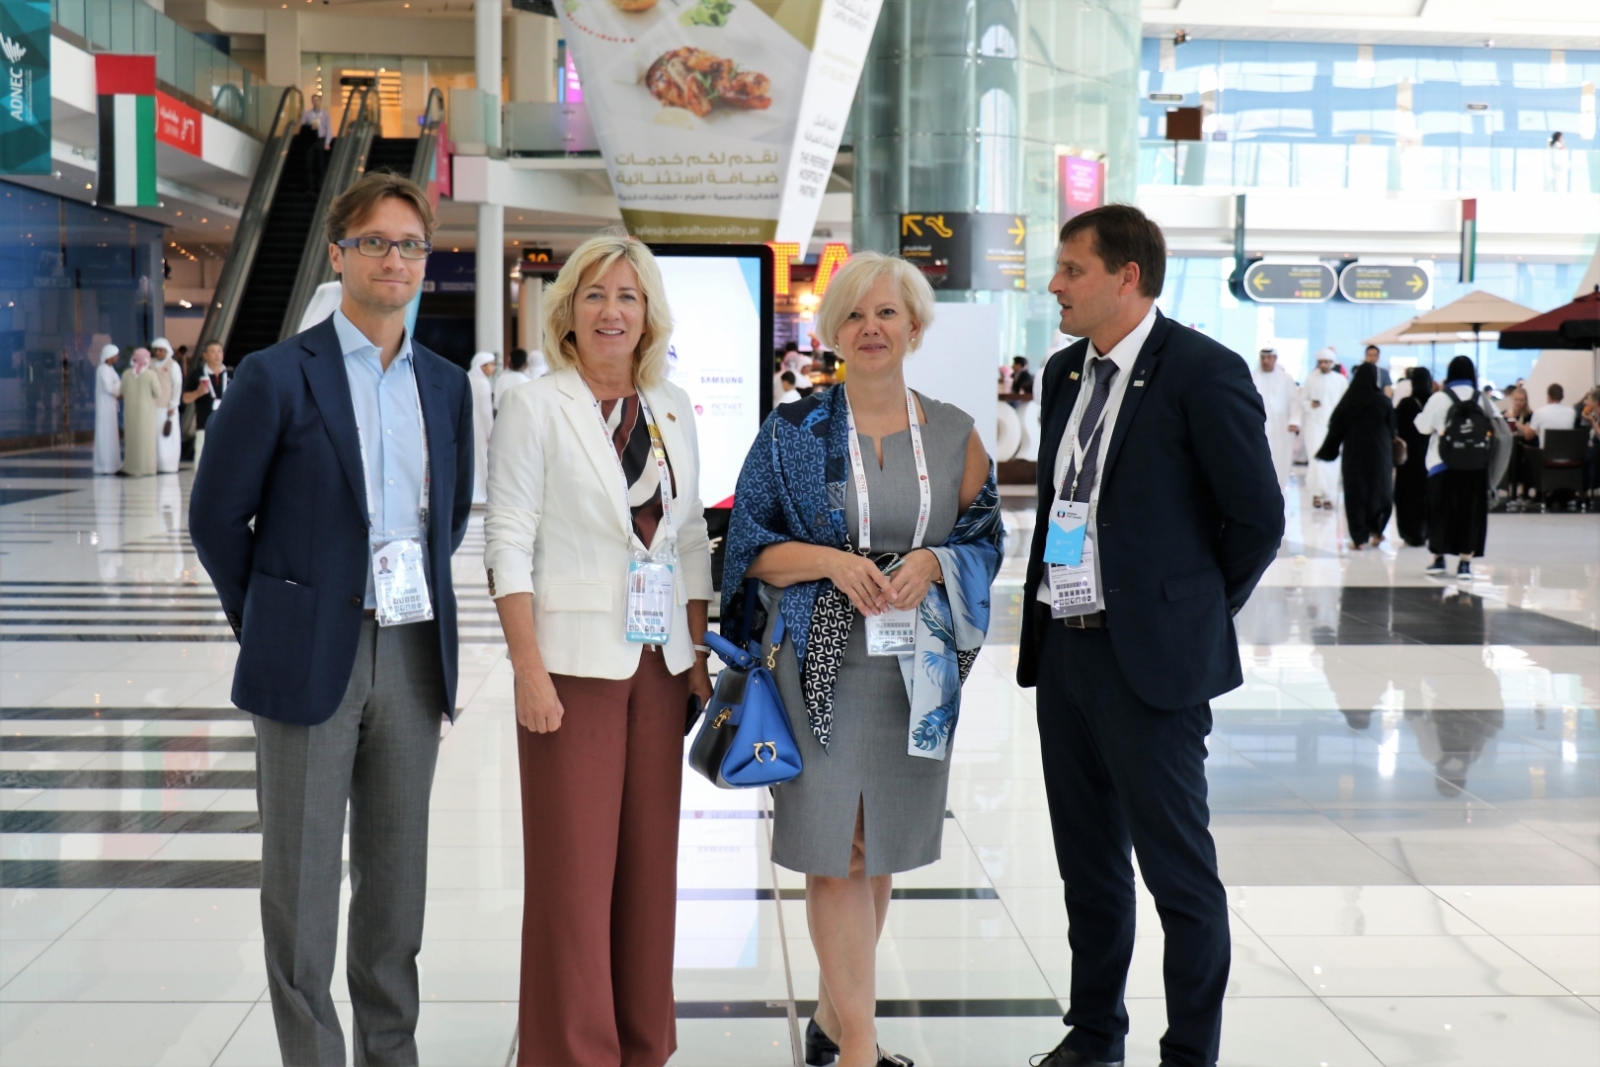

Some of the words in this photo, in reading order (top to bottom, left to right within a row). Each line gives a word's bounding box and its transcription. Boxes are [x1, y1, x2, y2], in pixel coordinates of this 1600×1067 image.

[10, 67, 23, 122] ADNEC
[615, 151, 683, 167] خدمات
[687, 152, 726, 168] لكم
[728, 149, 778, 167] نقدم
[616, 169, 703, 187] استثنائية
[707, 169, 779, 187] ضيافة
[700, 376, 744, 384] SAMSUNG
